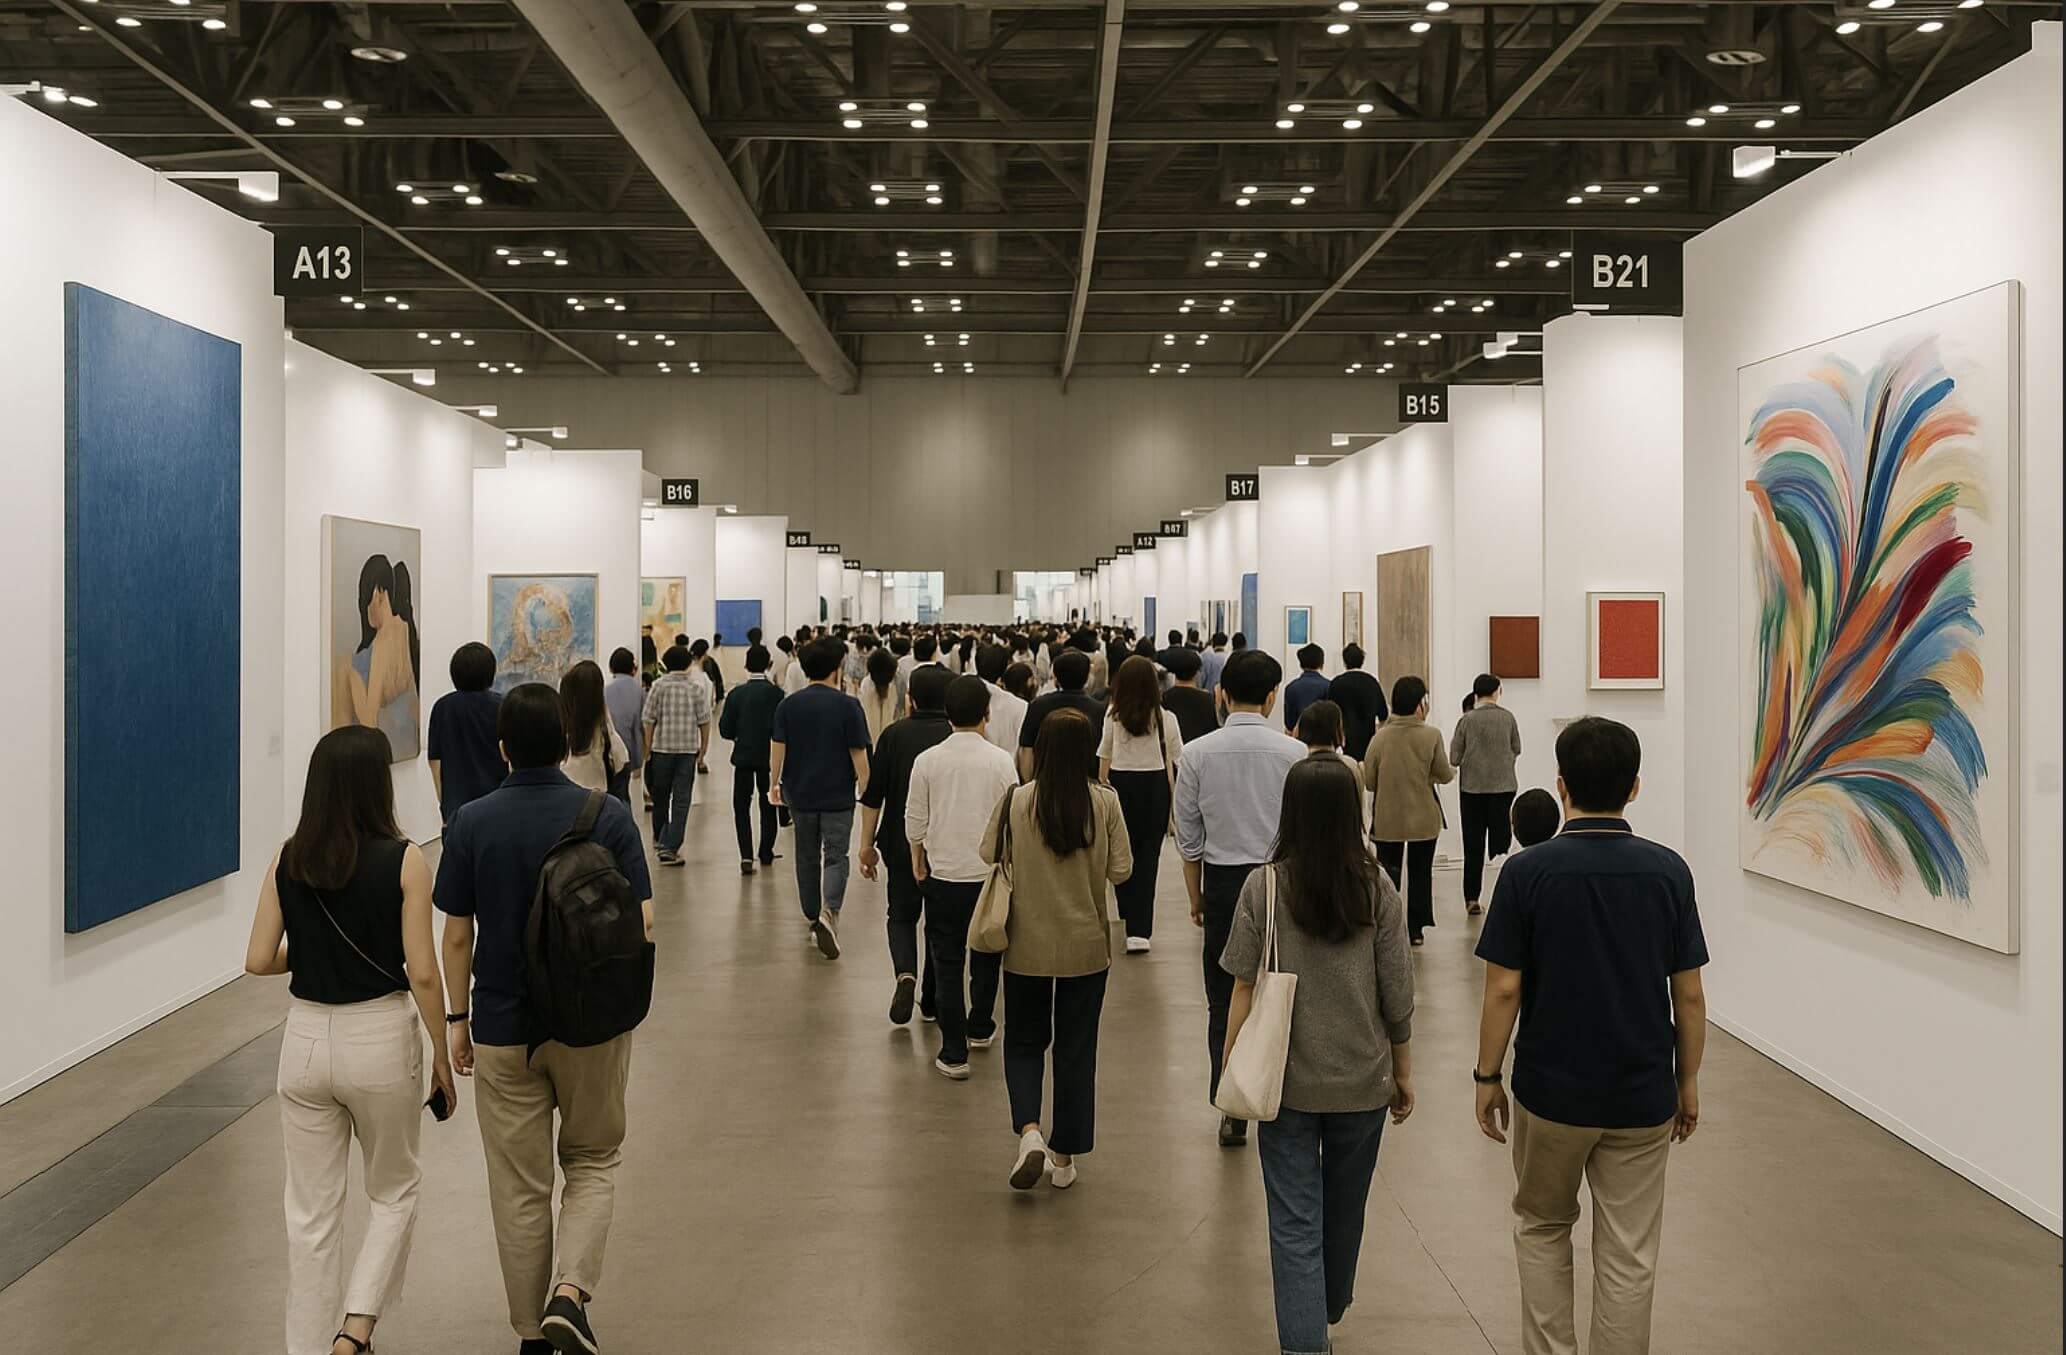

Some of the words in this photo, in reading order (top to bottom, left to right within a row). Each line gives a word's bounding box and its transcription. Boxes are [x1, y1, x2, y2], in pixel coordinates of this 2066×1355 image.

[292, 246, 351, 279] A13
[1593, 254, 1648, 288] B21
[1406, 395, 1440, 415] B15
[667, 484, 692, 500] B16
[1231, 480, 1254, 496] B17
